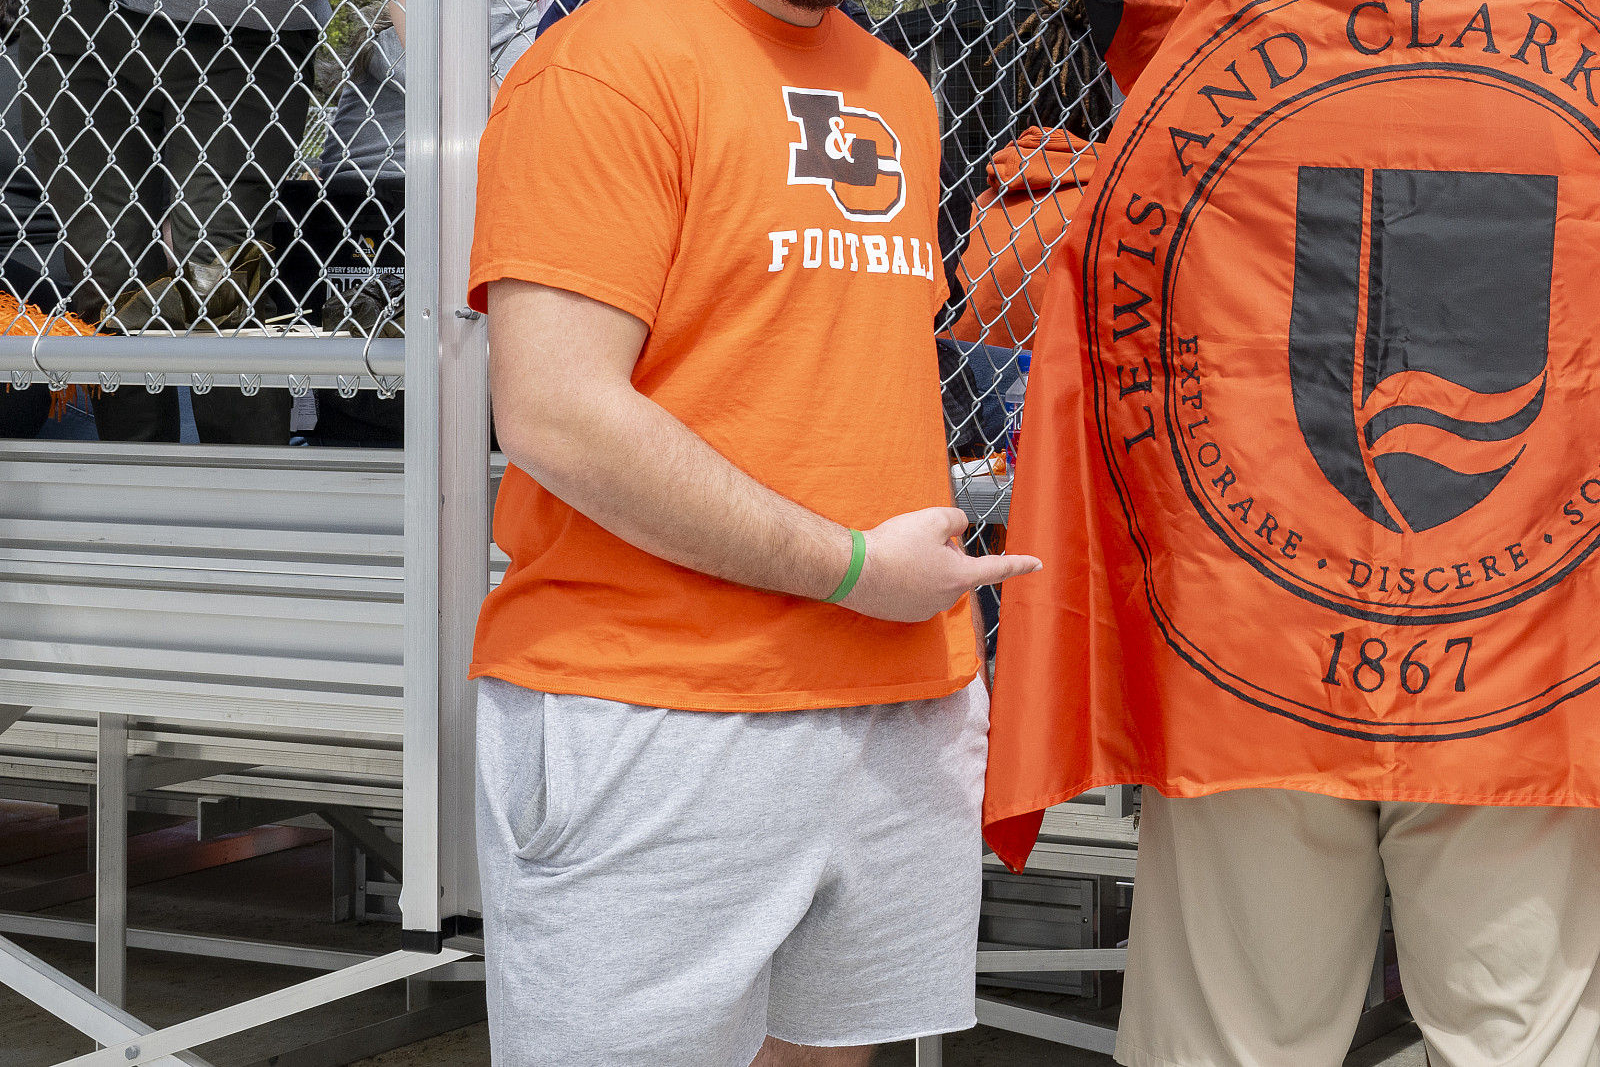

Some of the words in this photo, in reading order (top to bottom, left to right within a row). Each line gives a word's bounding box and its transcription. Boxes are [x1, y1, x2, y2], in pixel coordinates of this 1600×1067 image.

[767, 227, 934, 282] FOOTBALL
[1111, 191, 1169, 455] LEWIS
[1165, 30, 1310, 177] AND
[1176, 335, 1304, 556] EXPLORARE
[1347, 543, 1531, 595] DISCERE
[1322, 630, 1473, 695] 1867
